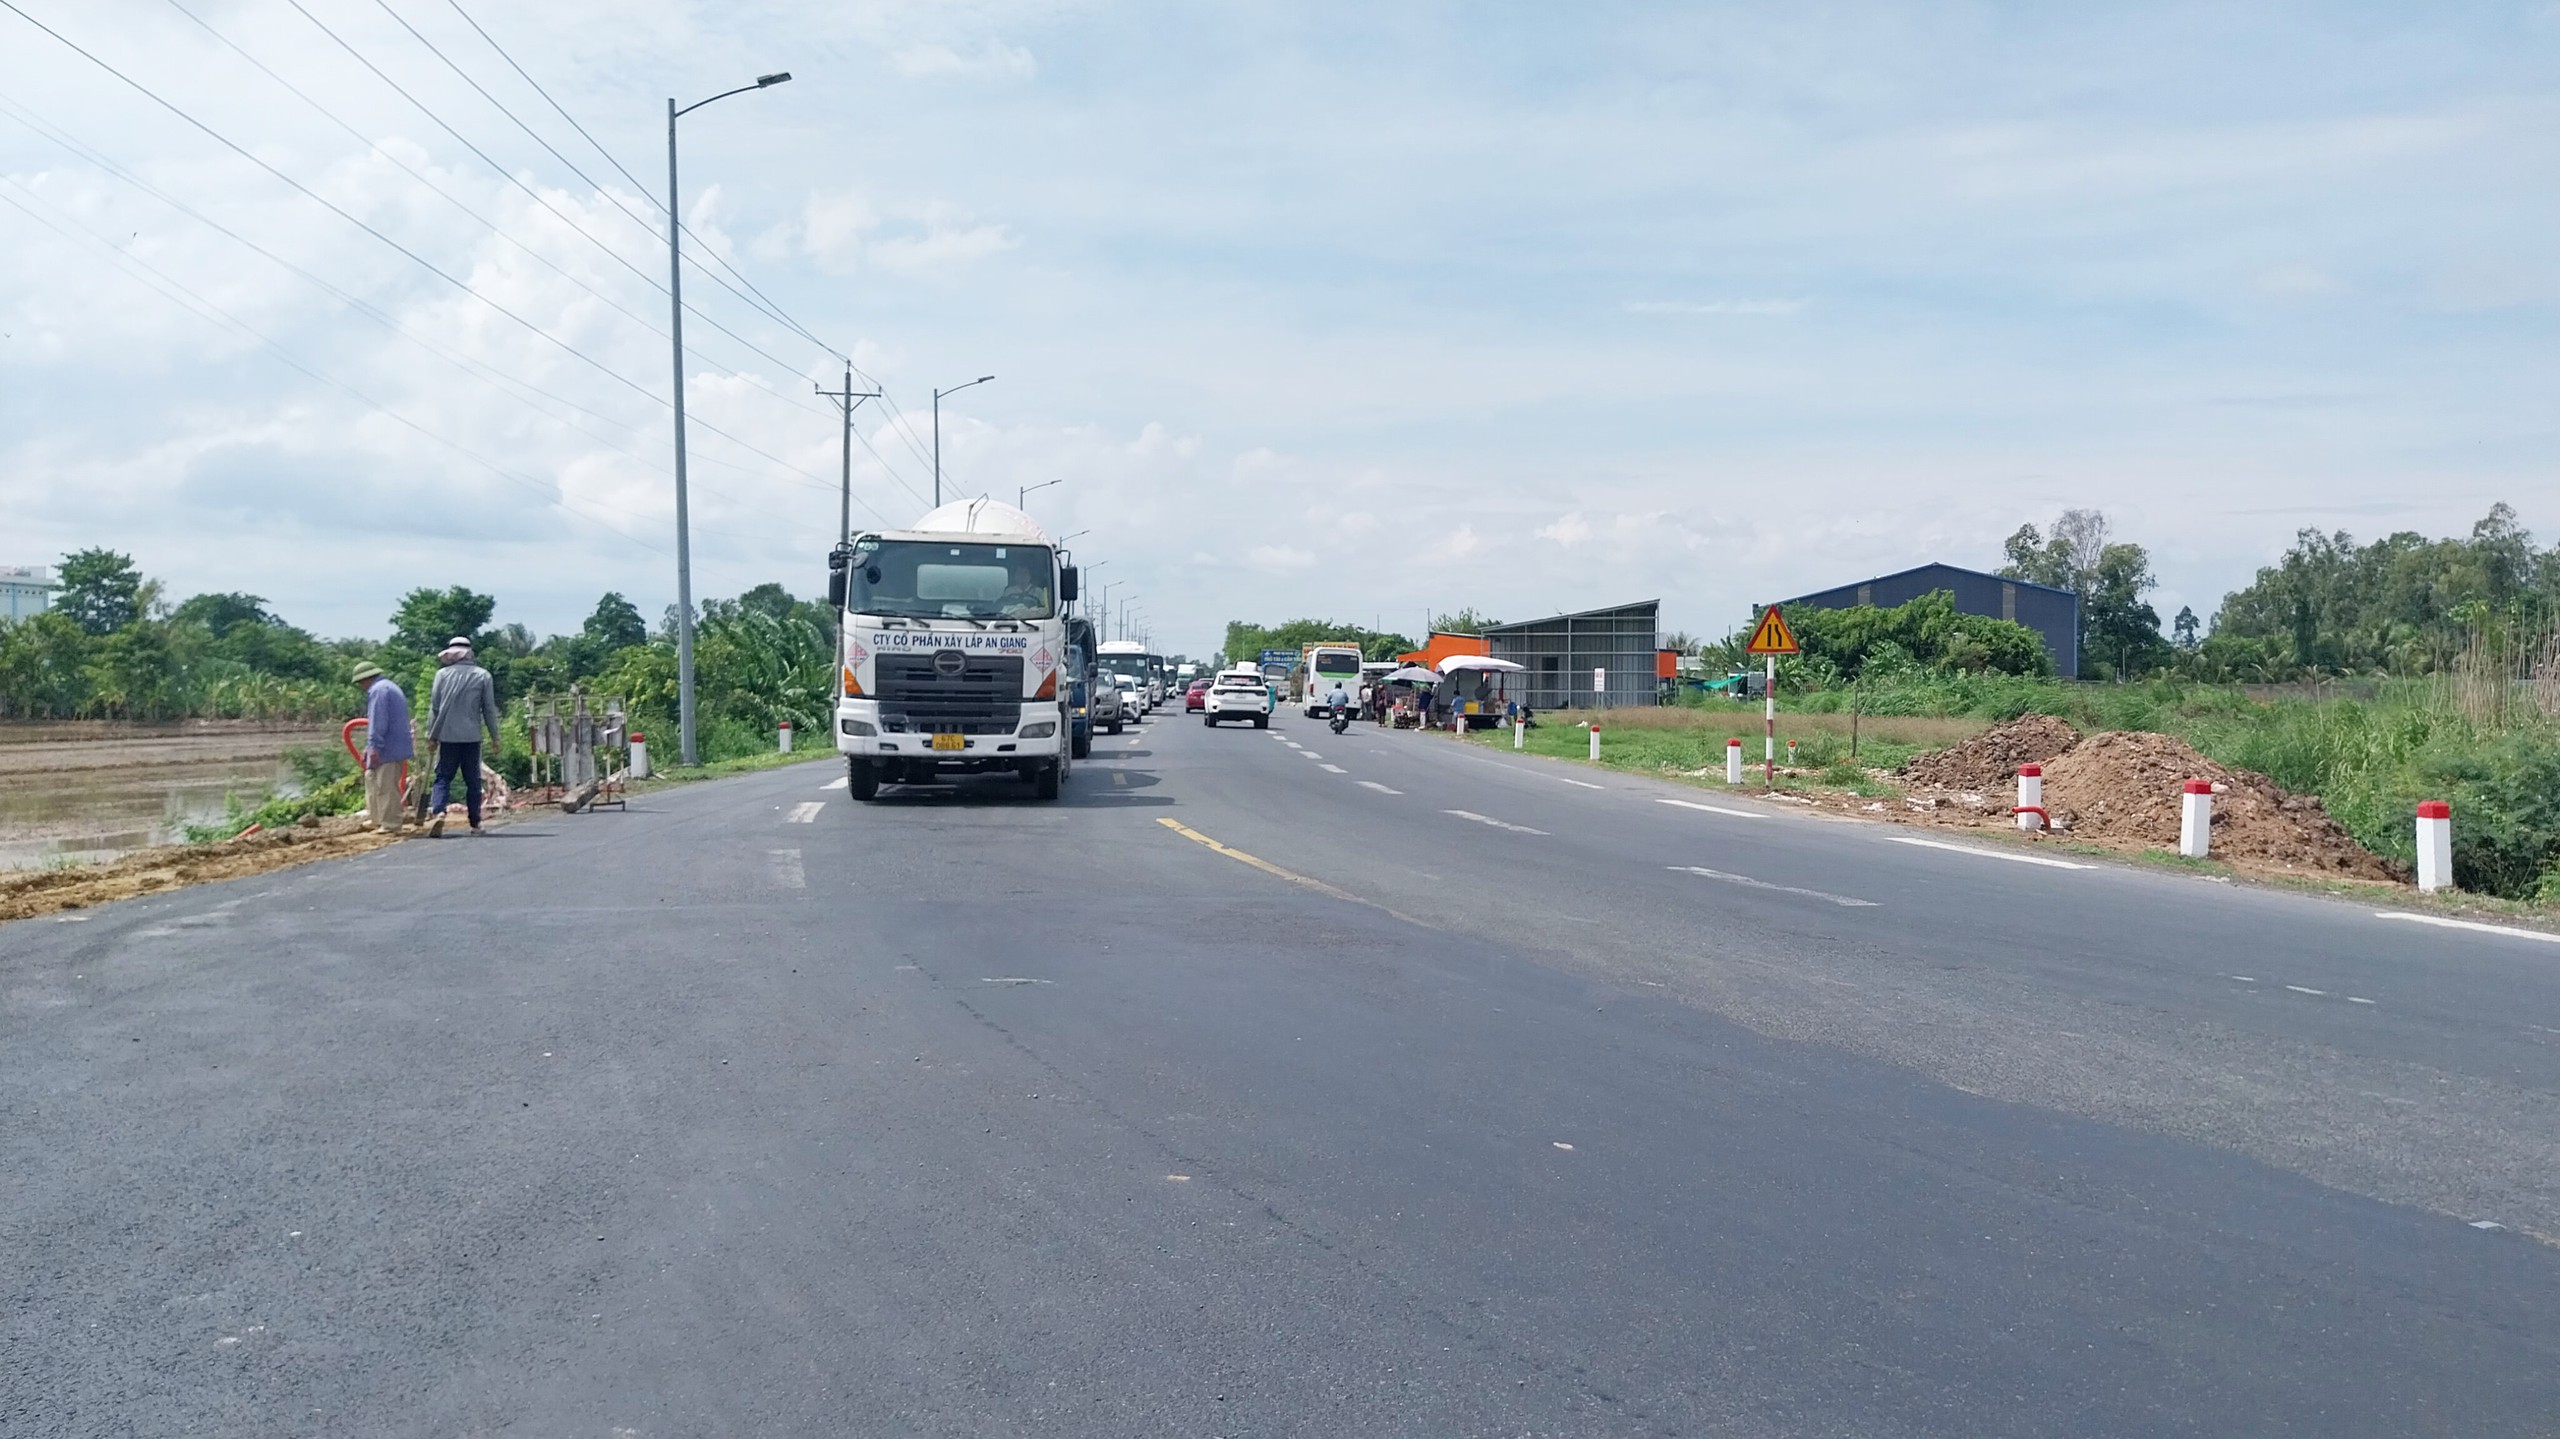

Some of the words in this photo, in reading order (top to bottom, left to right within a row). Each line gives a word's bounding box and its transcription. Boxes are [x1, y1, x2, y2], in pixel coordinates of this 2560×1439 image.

[873, 634, 891, 645] CTY
[985, 637, 997, 648] AN
[1000, 637, 1027, 649] GIANG
